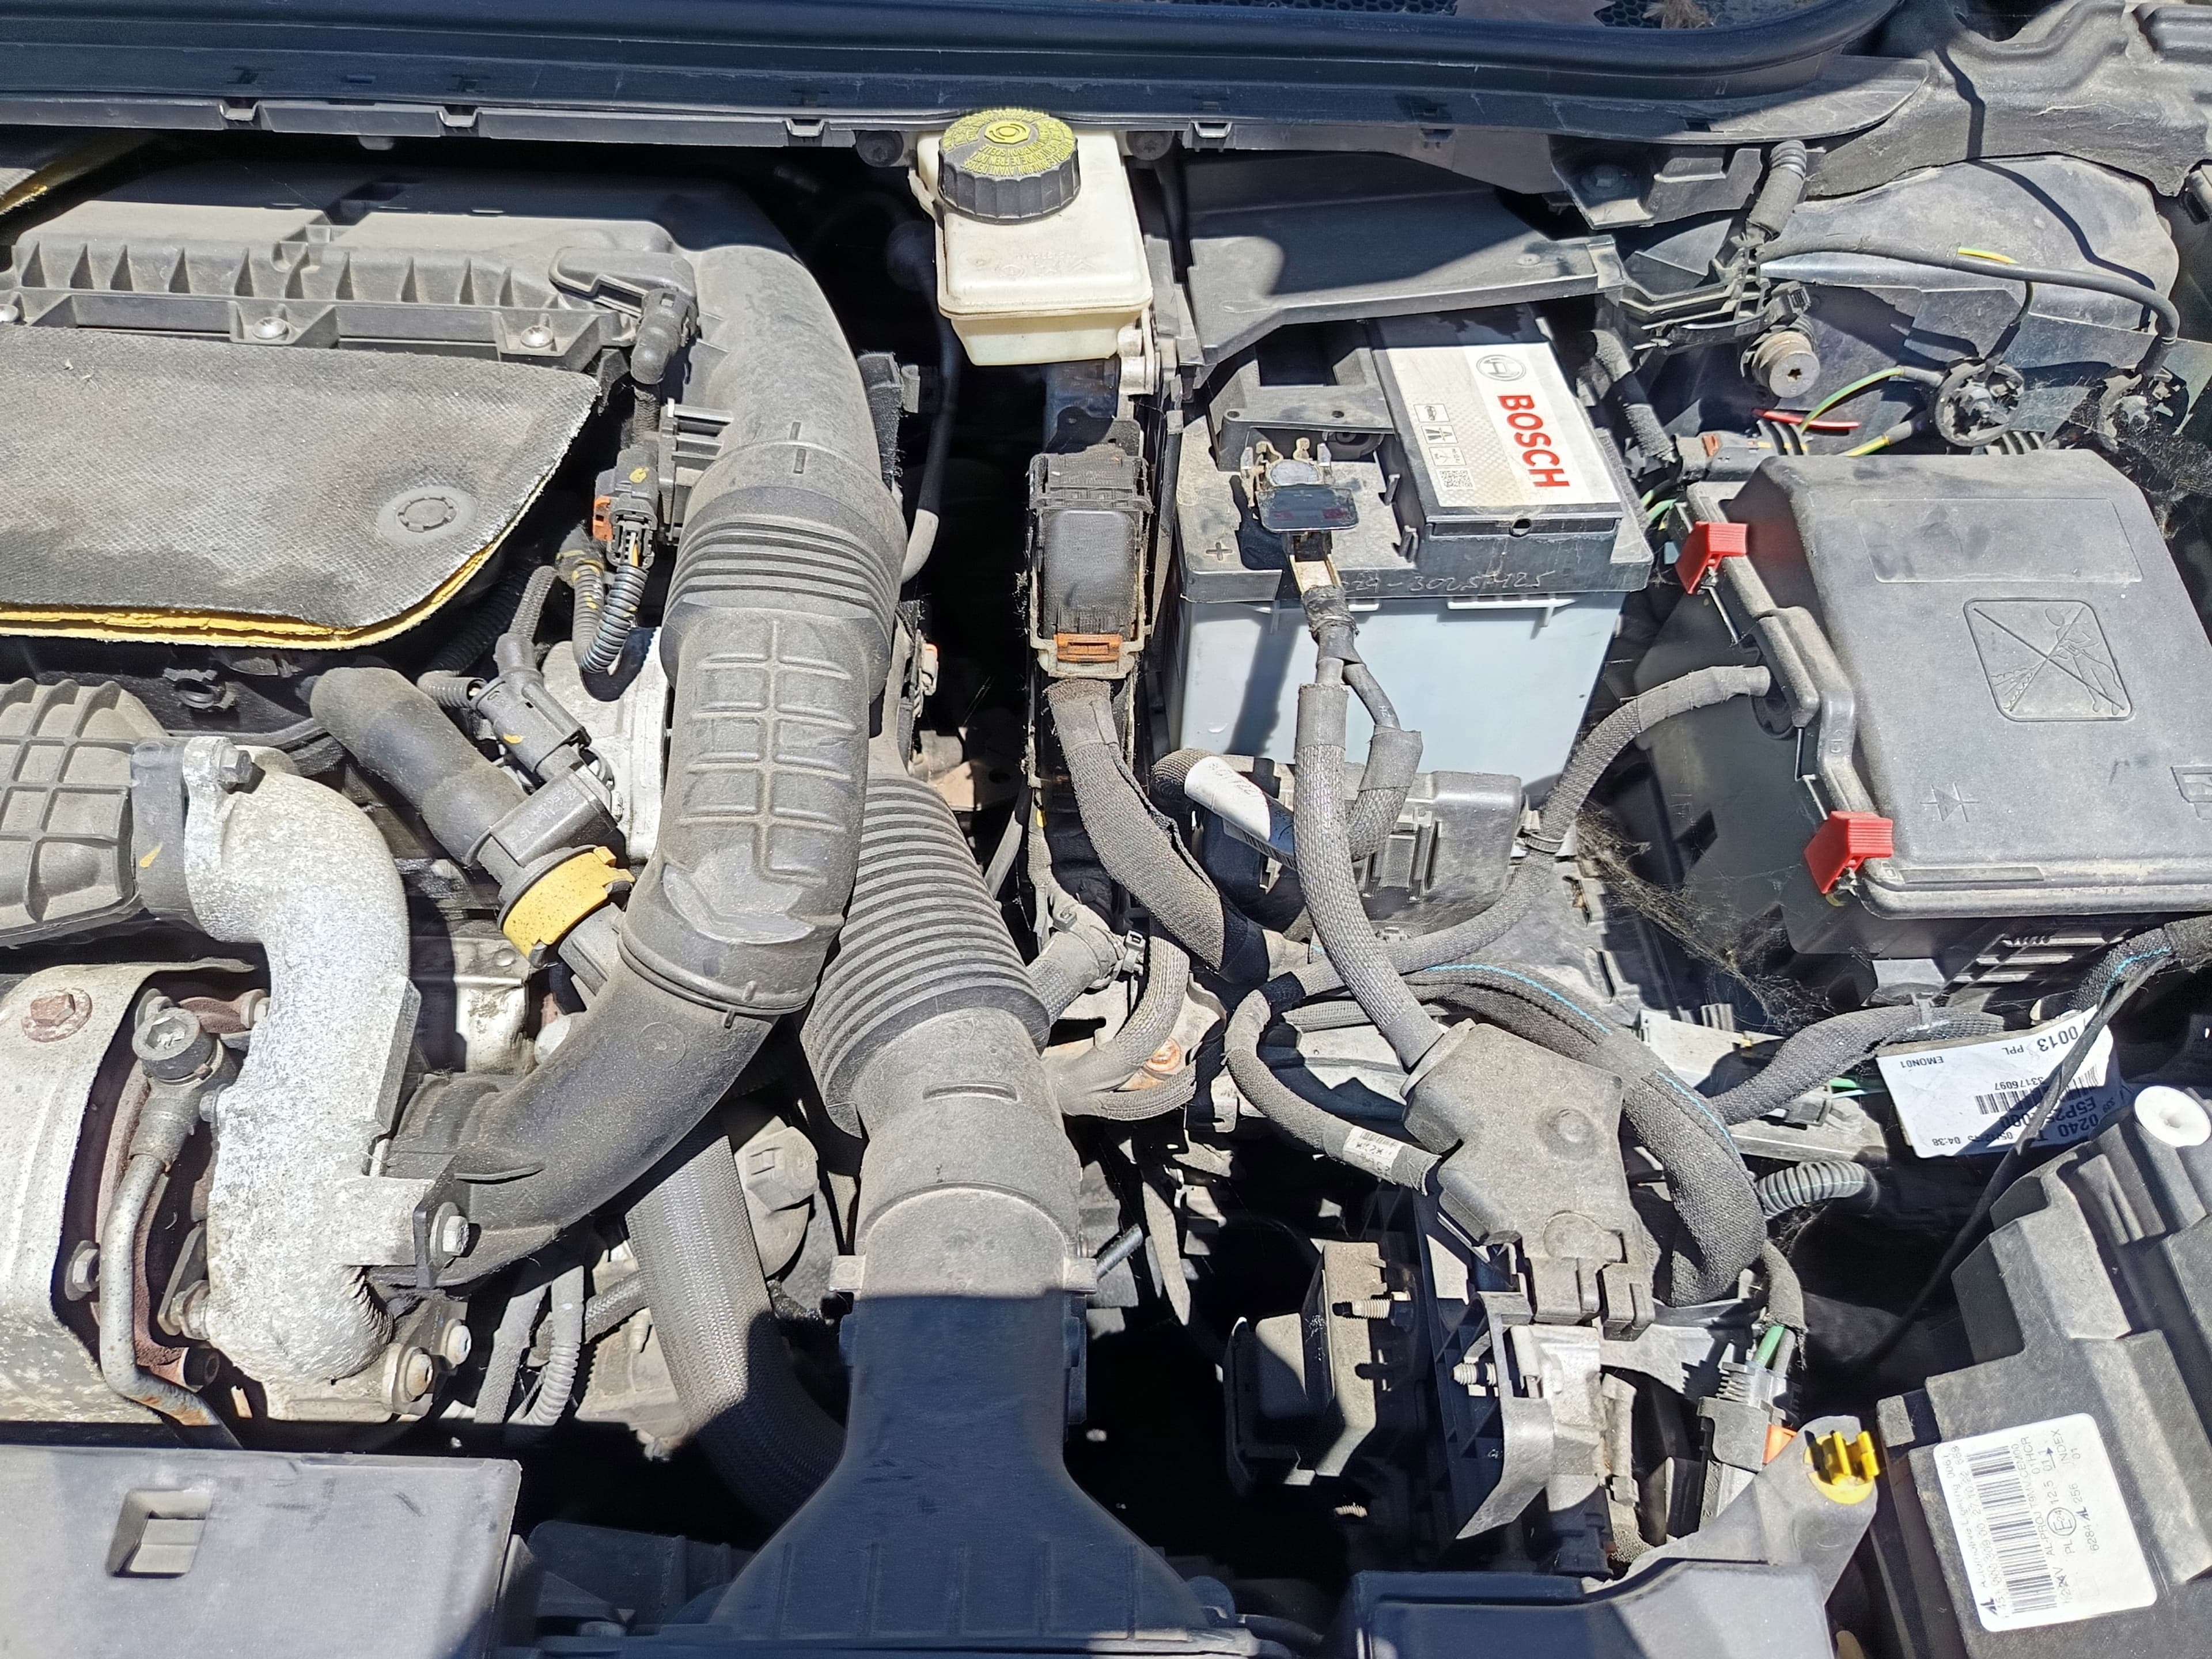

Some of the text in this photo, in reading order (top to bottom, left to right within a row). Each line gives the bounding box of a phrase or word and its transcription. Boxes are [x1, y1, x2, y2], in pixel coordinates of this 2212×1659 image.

[978, 143, 1033, 157] BIDON SCELLE
[959, 159, 987, 175] DEPOSE
[990, 155, 1009, 166] FREIN
[1010, 157, 1020, 165] DE
[1018, 159, 1049, 175] BOUCHON
[988, 165, 1013, 177] AVANT
[1498, 394, 1570, 487] BOSCH
[1900, 1026, 2078, 1068] 0013 PPL EMON01
[1995, 1076, 2044, 1090] 33176097
[2058, 1114, 2099, 1137] 0240
[1932, 1137, 1961, 1146] 04:38
[2051, 1429, 2070, 1464] INDEX
[2071, 1448, 2081, 1460] 01
[2011, 1444, 2028, 1478] CEM00
[2043, 1480, 2059, 1505] 12.5
[2069, 1483, 2083, 1503] 256
[1977, 1522, 1988, 1537] 00
[2033, 1511, 2055, 1556] AL-PROJ
[2084, 1525, 2100, 1551] 6284
[2064, 1539, 2075, 1554] PL
